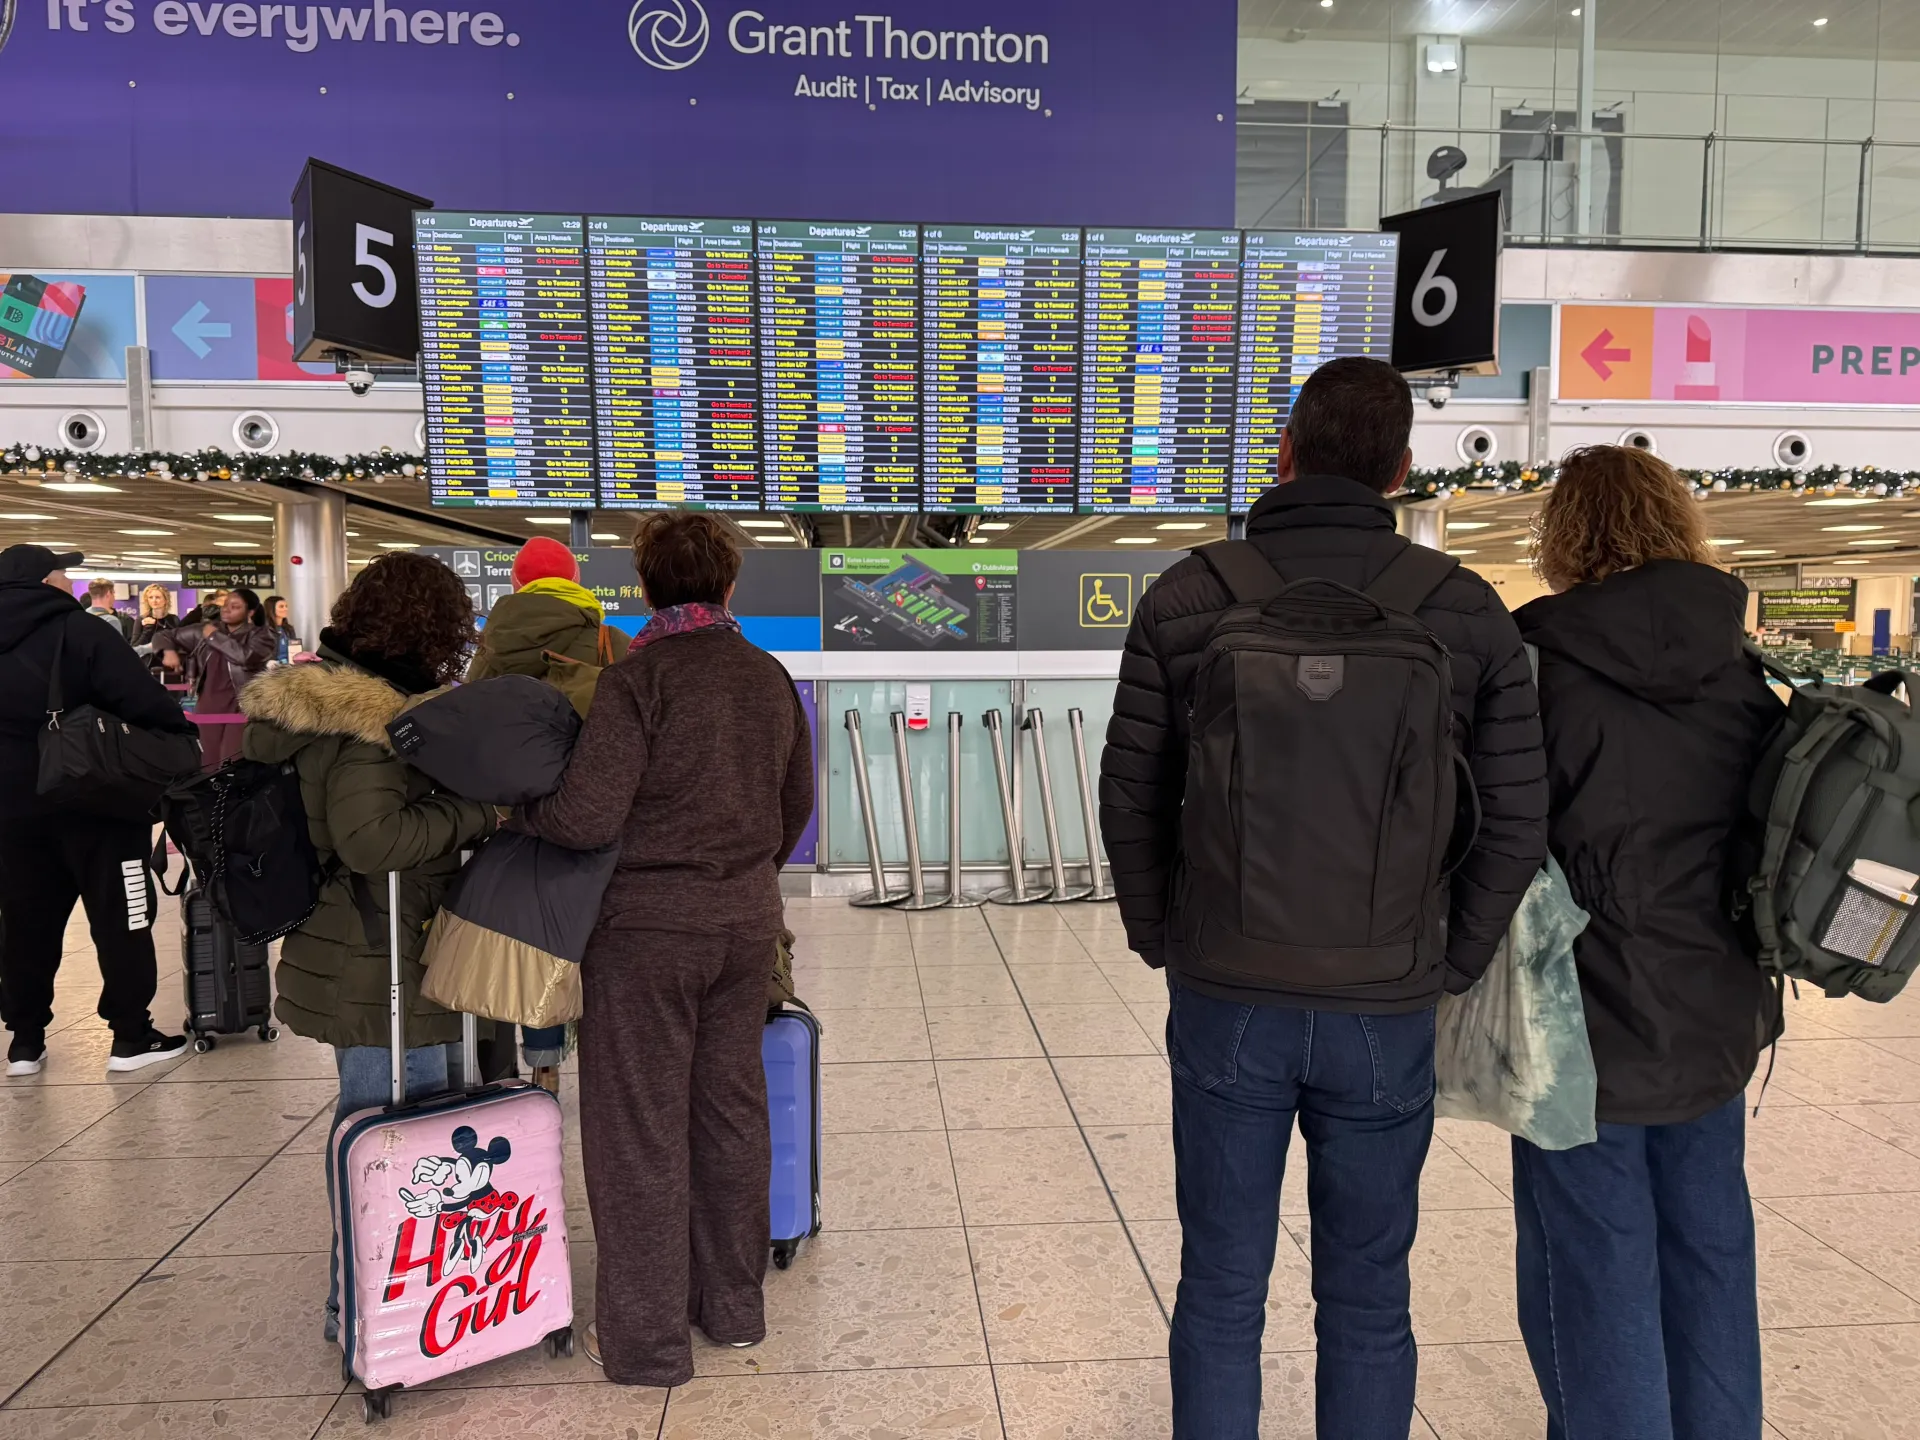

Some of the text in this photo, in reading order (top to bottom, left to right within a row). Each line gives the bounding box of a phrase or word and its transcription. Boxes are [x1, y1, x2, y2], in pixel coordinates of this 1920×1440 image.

[47, 0, 521, 53] Its everywhere.
[727, 10, 1049, 64] Grant Thornton
[794, 74, 1040, 111] Audit Tax Advisory
[470, 218, 517, 228] Departures
[641, 222, 688, 232] Departures
[809, 226, 855, 237] Departures
[974, 230, 1019, 241] Departures
[1136, 233, 1180, 244] Departures
[1295, 236, 1338, 247] Departures
[298, 221, 307, 306] 5
[351, 222, 398, 309] 5
[1410, 247, 1459, 328] 6
[0, 350, 33, 368] UTY FREE
[1812, 344, 1920, 376] PREP
[484, 565, 512, 576] Term
[230, 575, 257, 586] 9-14
[592, 586, 616, 597] chta
[602, 600, 620, 610] tes
[121, 858, 149, 931] PUMA
[419, 1232, 543, 1359] Girl
